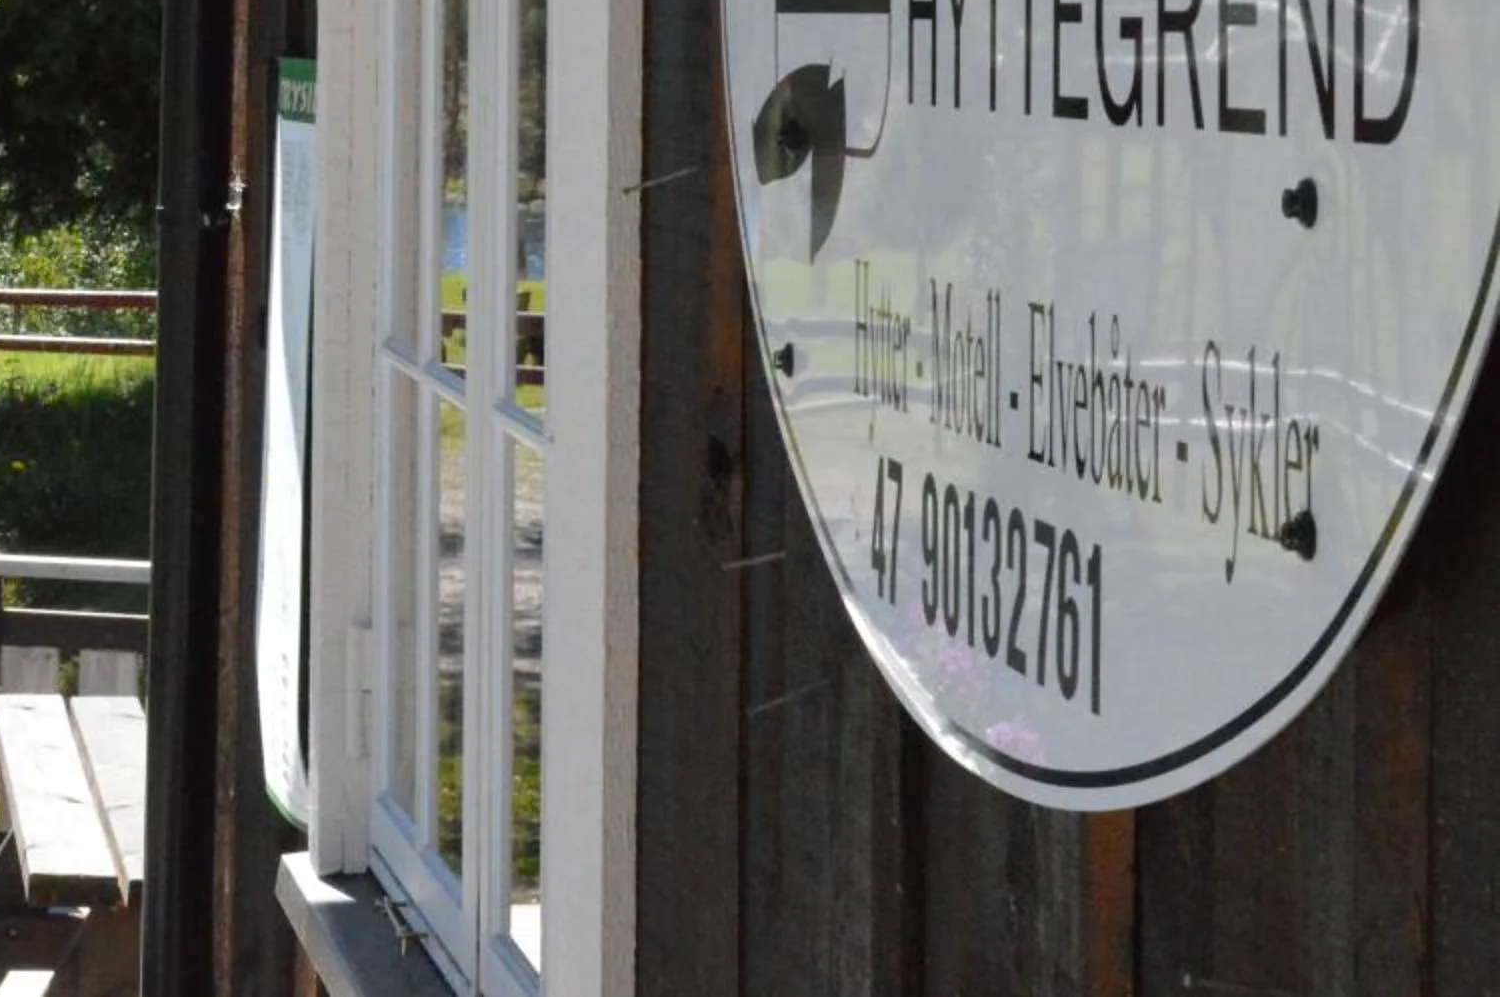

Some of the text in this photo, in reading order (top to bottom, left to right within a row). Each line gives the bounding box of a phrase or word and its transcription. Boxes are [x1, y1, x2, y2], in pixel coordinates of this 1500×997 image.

[929, 277, 1002, 449] Motell
[1028, 300, 1166, 504] Elvebåter
[1201, 339, 1320, 585] Sykler
[871, 455, 1102, 716] 47 90132761
